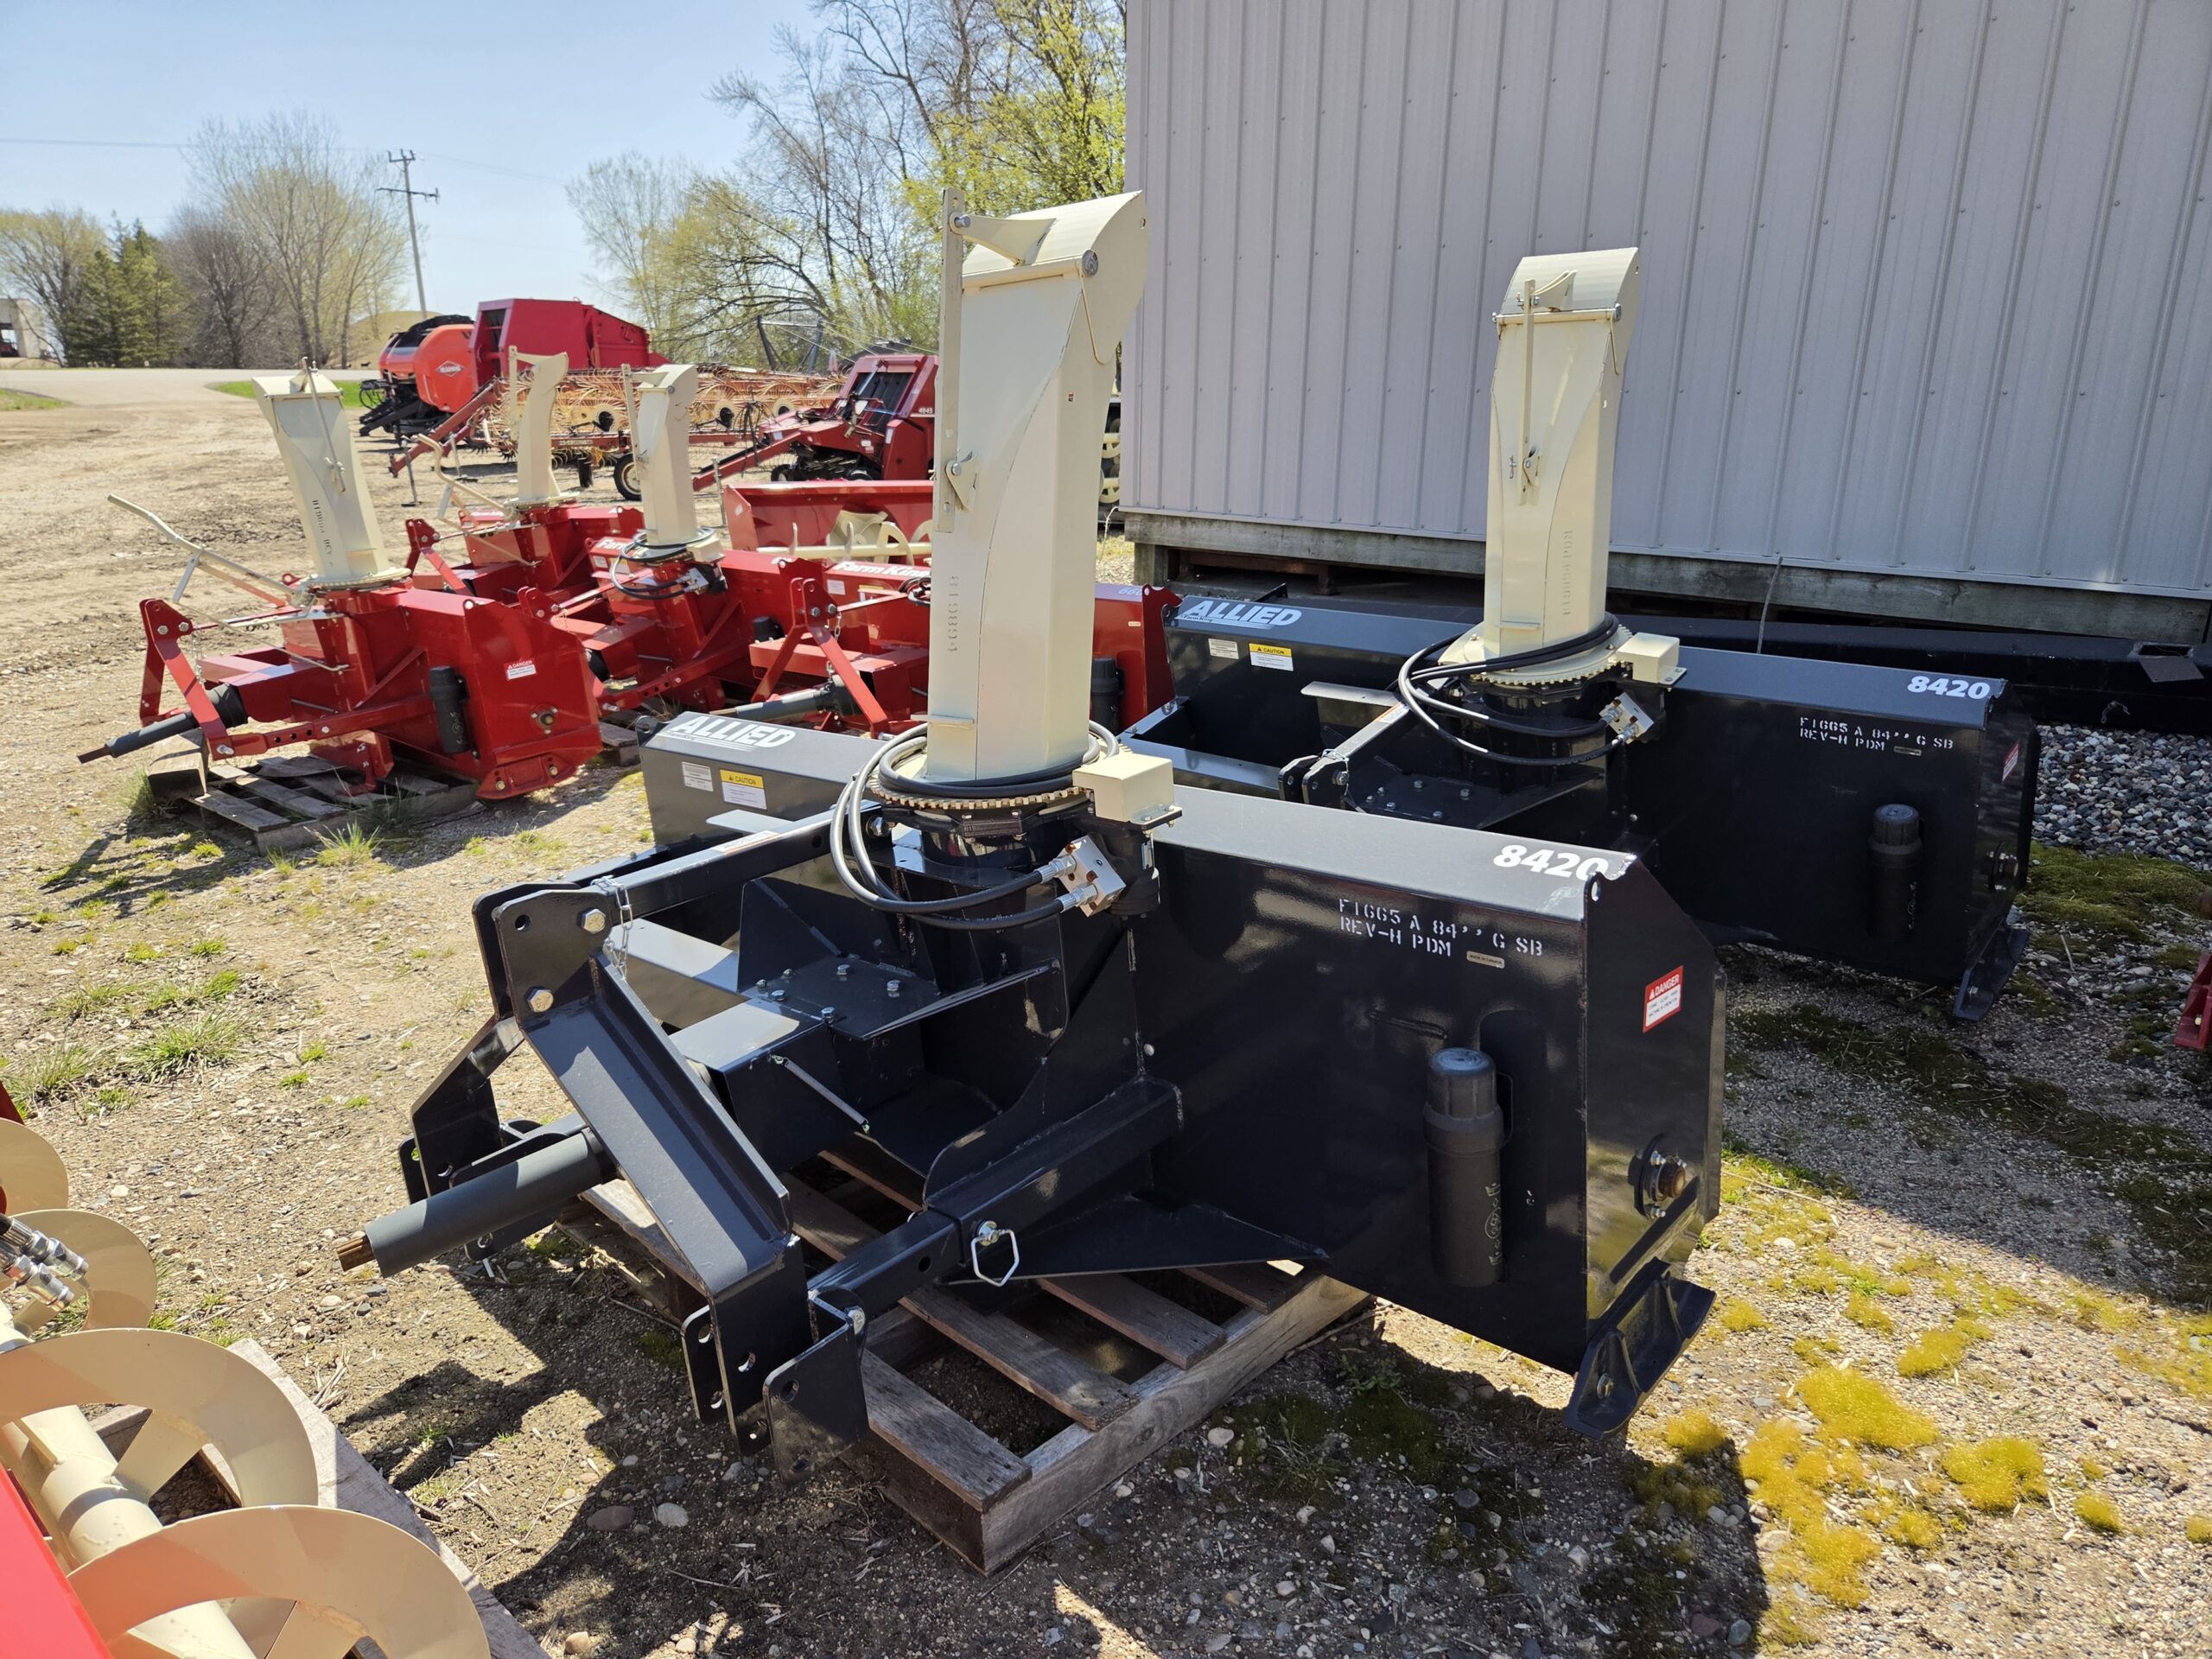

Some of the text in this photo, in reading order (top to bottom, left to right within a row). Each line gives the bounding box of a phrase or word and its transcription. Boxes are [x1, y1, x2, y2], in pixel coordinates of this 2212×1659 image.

[1184, 601, 1302, 626] ALLIED
[1907, 675, 1991, 700] 8420
[671, 715, 797, 748] ALLIED
[1800, 728, 1847, 746] REV-H
[1856, 738, 1885, 752] PDM
[1854, 726, 1863, 737] A
[1933, 737, 1954, 750] SB
[734, 775, 757, 785] CAUTION
[1493, 844, 1609, 881] 8420
[1340, 915, 1452, 957] REV-H PDM
[1410, 914, 1421, 931] A
[1492, 932, 1506, 950] G
[1516, 937, 1543, 957] SB
[1655, 973, 1680, 997] DANGER
